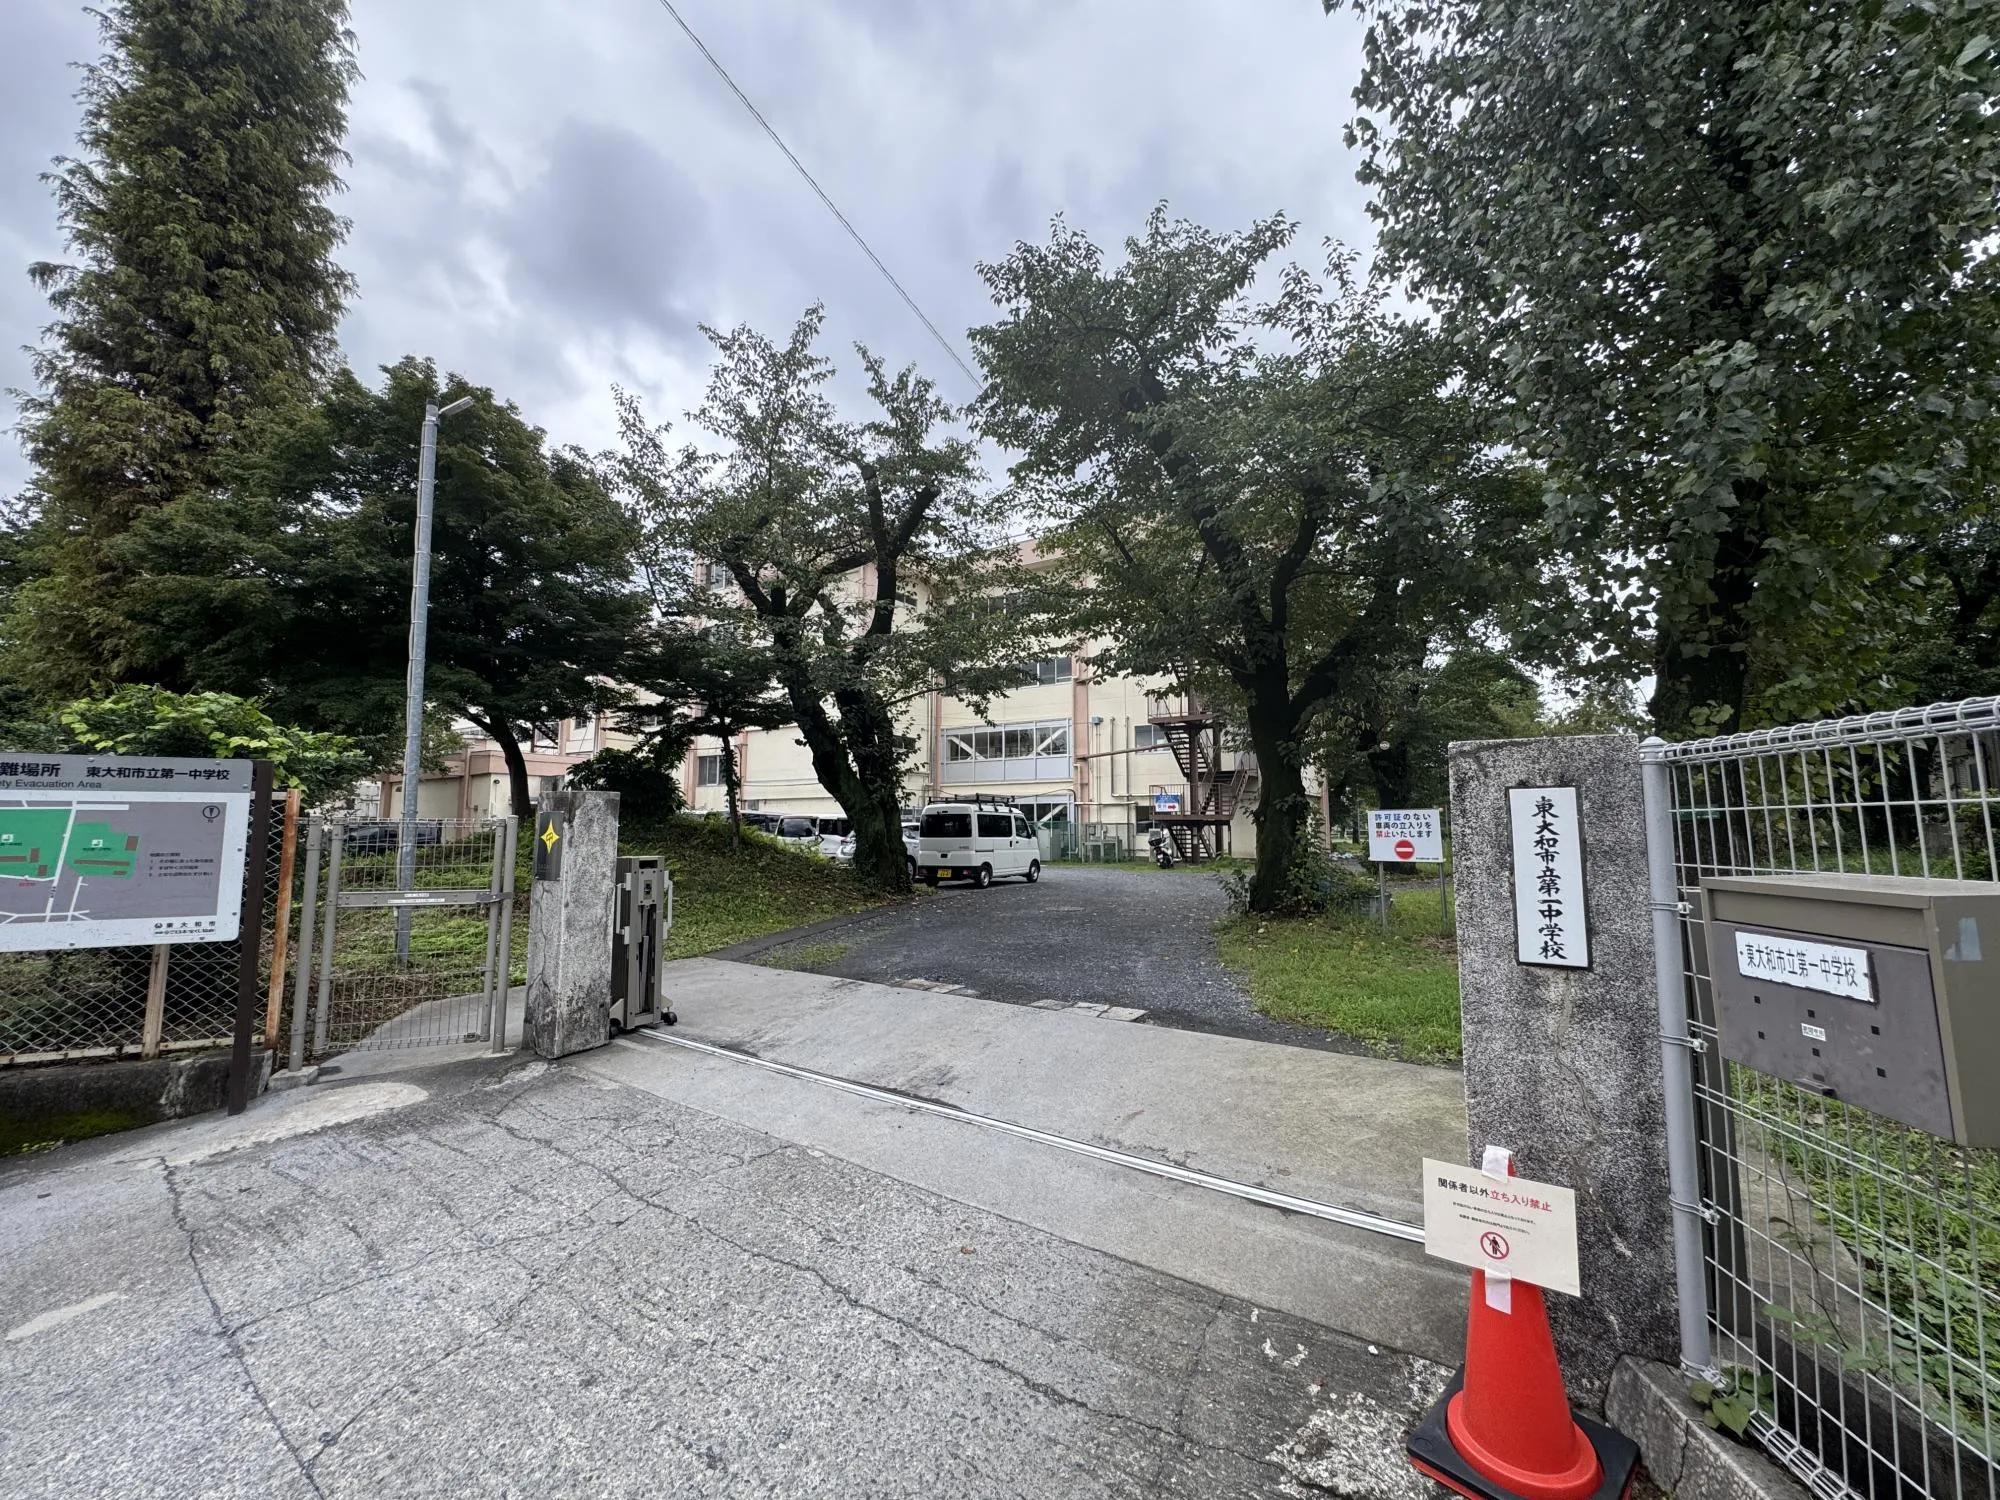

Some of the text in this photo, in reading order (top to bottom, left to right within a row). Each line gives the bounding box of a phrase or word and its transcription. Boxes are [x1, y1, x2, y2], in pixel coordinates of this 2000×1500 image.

[86, 766, 231, 780] 東大和市立第一中学校
[15, 779, 74, 788] Evacuation
[76, 780, 102, 789] Area
[1374, 813, 1431, 821] 許可証のない
[1375, 821, 1432, 830] 車両の立入りを
[1376, 830, 1433, 838] 禁止いたします
[1531, 795, 1568, 960] 東大和市立第一中学校
[1745, 942, 1858, 987] 東大和市立第一中学校
[1438, 1177, 1553, 1213] 関係者以外立ち入り禁止
